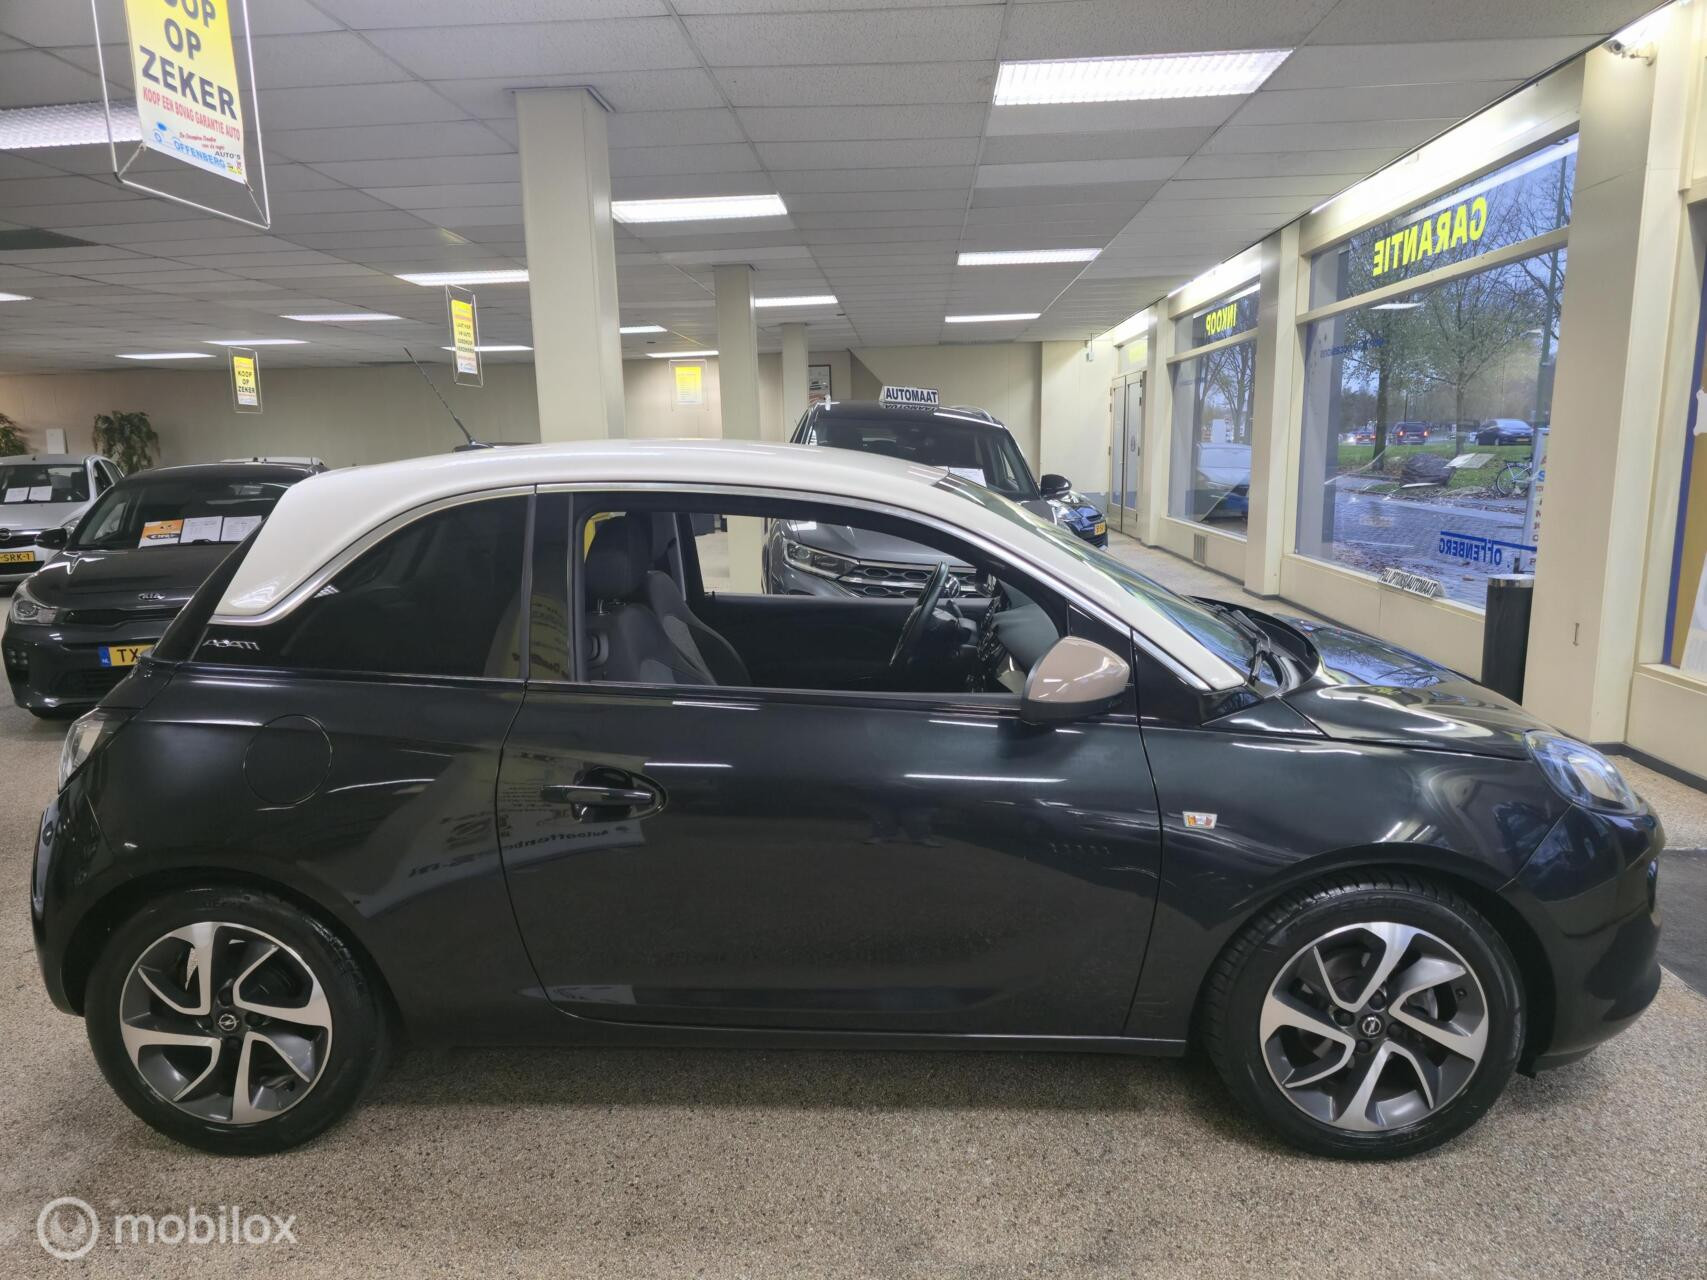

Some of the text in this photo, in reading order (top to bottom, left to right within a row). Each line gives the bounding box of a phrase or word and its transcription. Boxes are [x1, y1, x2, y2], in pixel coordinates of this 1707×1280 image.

[164, 18, 201, 60] OP
[139, 45, 237, 120] ZEKER
[143, 86, 240, 141] KOOP EEN BOVAG GARANTIE AUTO
[174, 140, 226, 169] OFFENBERG
[885, 387, 937, 403] AUTOMAAT
